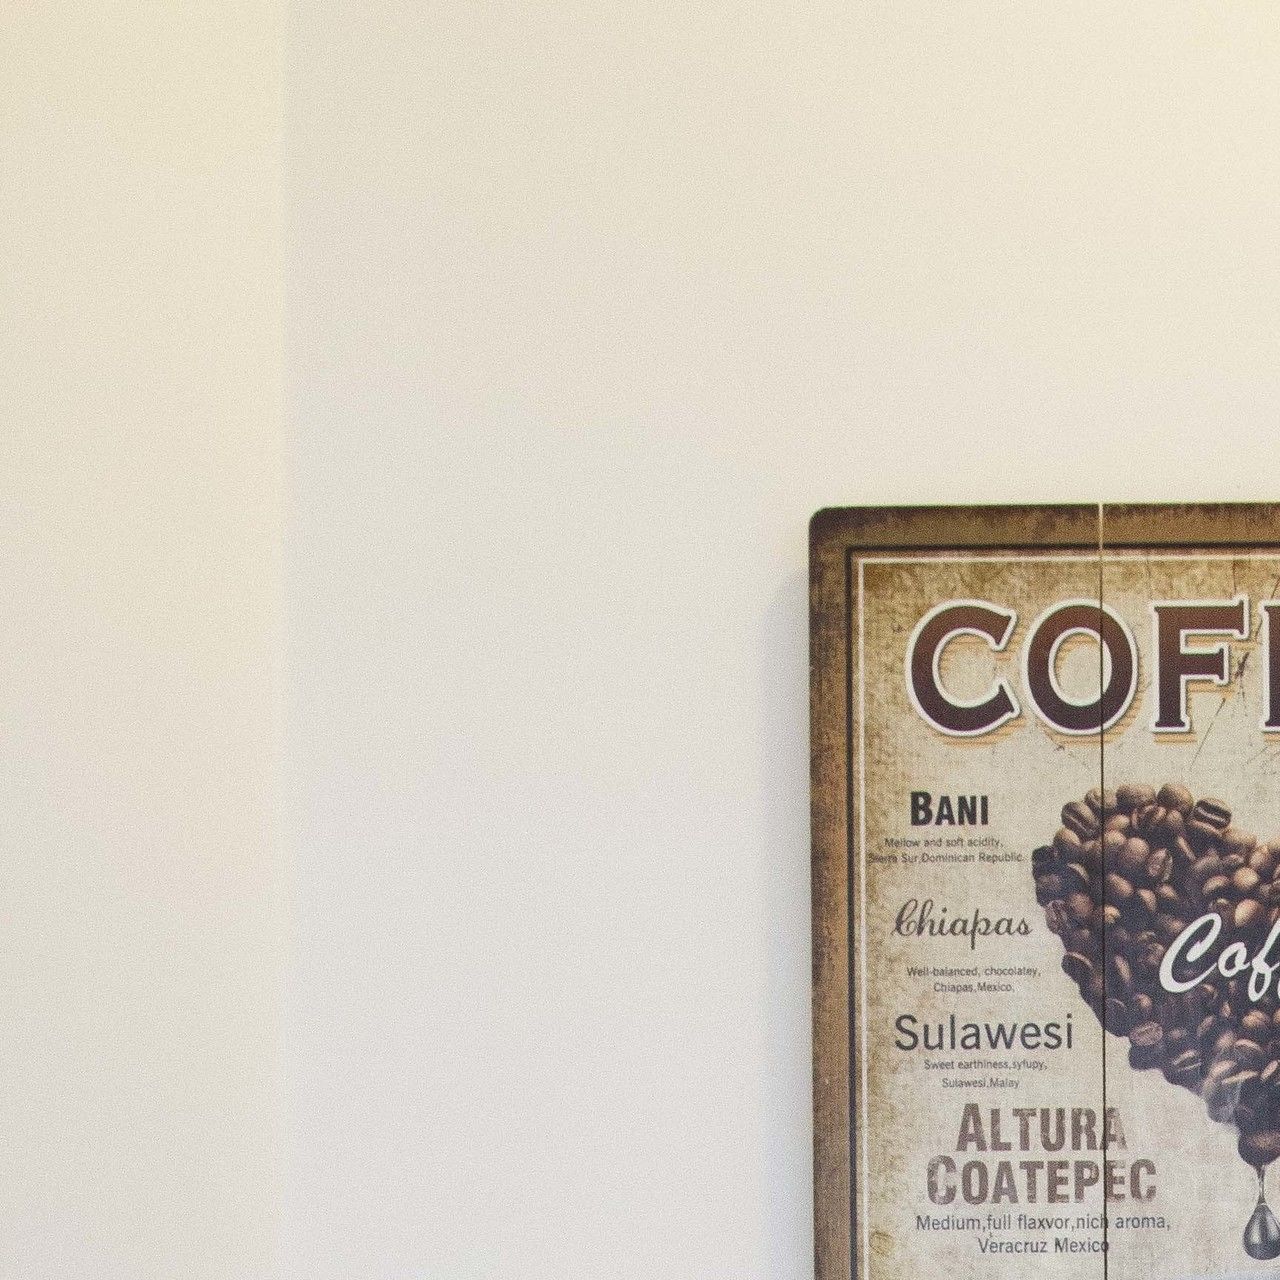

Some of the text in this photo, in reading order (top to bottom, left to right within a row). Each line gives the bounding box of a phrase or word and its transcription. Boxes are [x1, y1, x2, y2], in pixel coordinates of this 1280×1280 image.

[911, 791, 989, 826] BANI
[924, 838, 942, 848] and
[946, 837, 964, 848] soft
[890, 898, 1034, 950] Chiapas
[894, 1013, 1073, 1051] Sulawesi
[923, 1060, 955, 1070] Sweet
[955, 1102, 1129, 1152] ALTURA
[926, 1155, 1157, 1205] COATEPEC
[1115, 1215, 1171, 1233] aroma,
[978, 1237, 1110, 1254] Veracruz Mexico
